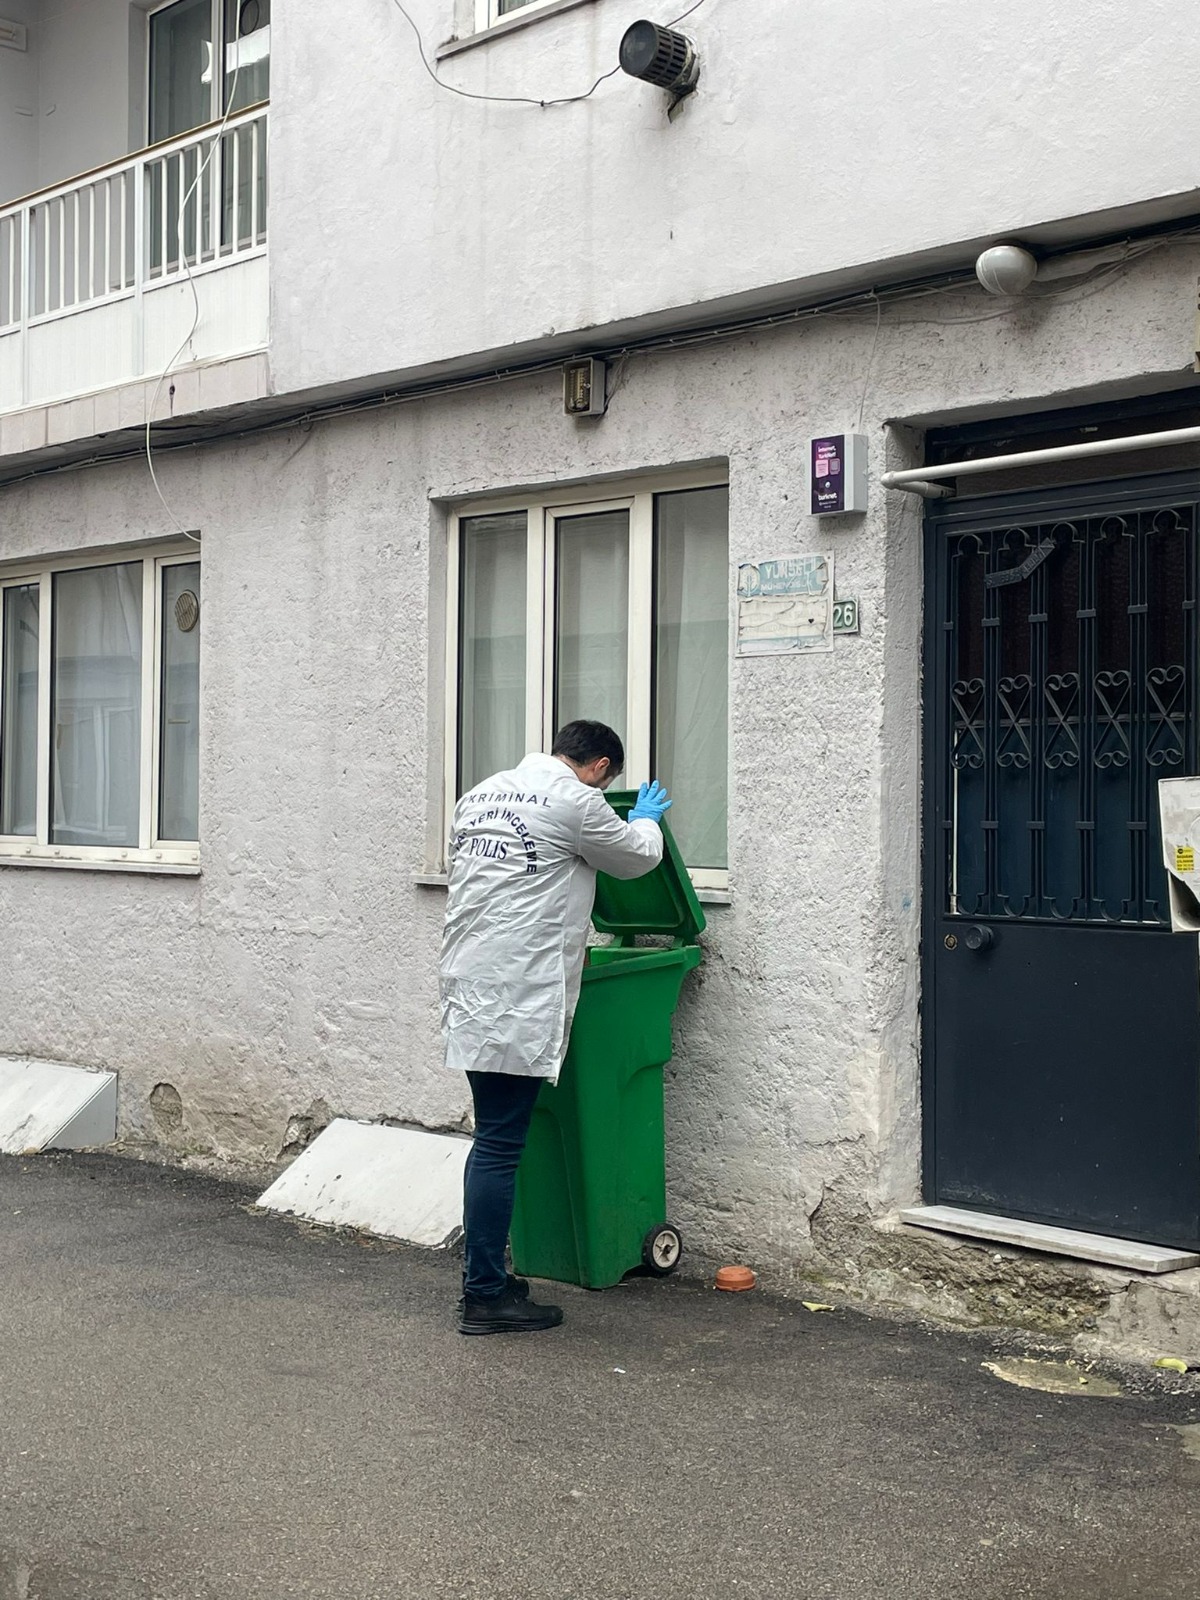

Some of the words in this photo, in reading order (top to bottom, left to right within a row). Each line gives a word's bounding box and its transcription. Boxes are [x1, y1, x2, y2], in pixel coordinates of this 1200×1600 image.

[833, 604, 854, 628] 26
[469, 792, 551, 808] KRİMİNAL
[469, 807, 499, 827] YERİ
[501, 807, 537, 873] İNCELEME
